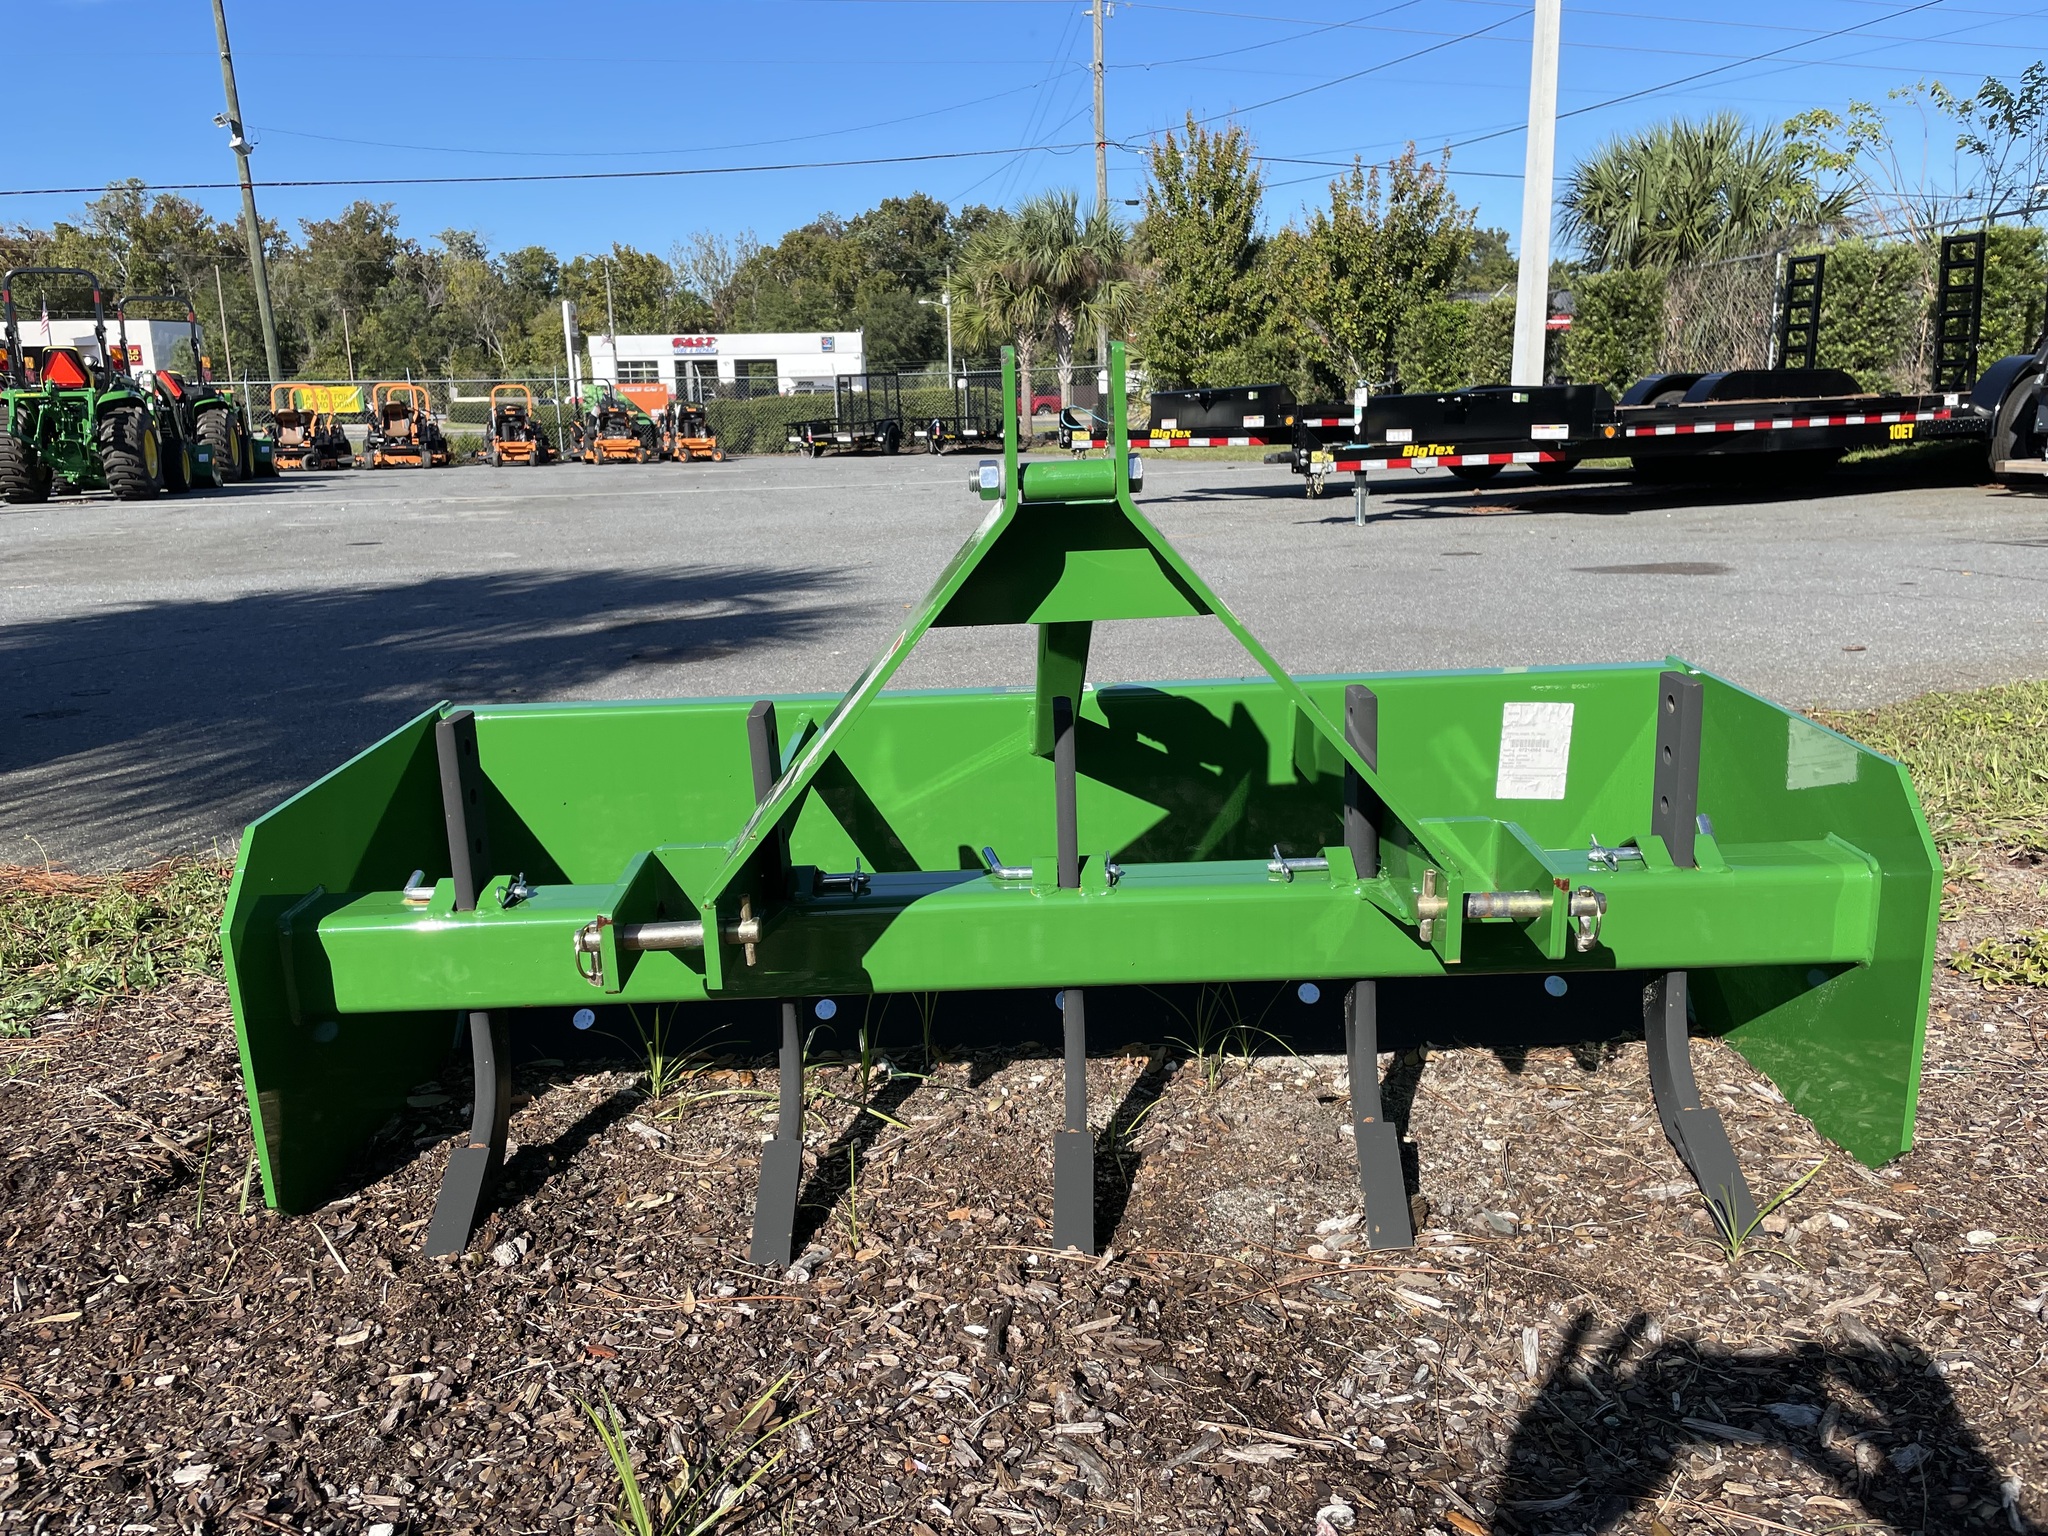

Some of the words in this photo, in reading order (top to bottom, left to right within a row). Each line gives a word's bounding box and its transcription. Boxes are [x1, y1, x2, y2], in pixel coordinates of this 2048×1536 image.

[672, 337, 717, 347] FAST
[1149, 428, 1192, 440] BigTex
[1889, 423, 1915, 440] 10ET
[1402, 443, 1456, 458] BigTex
